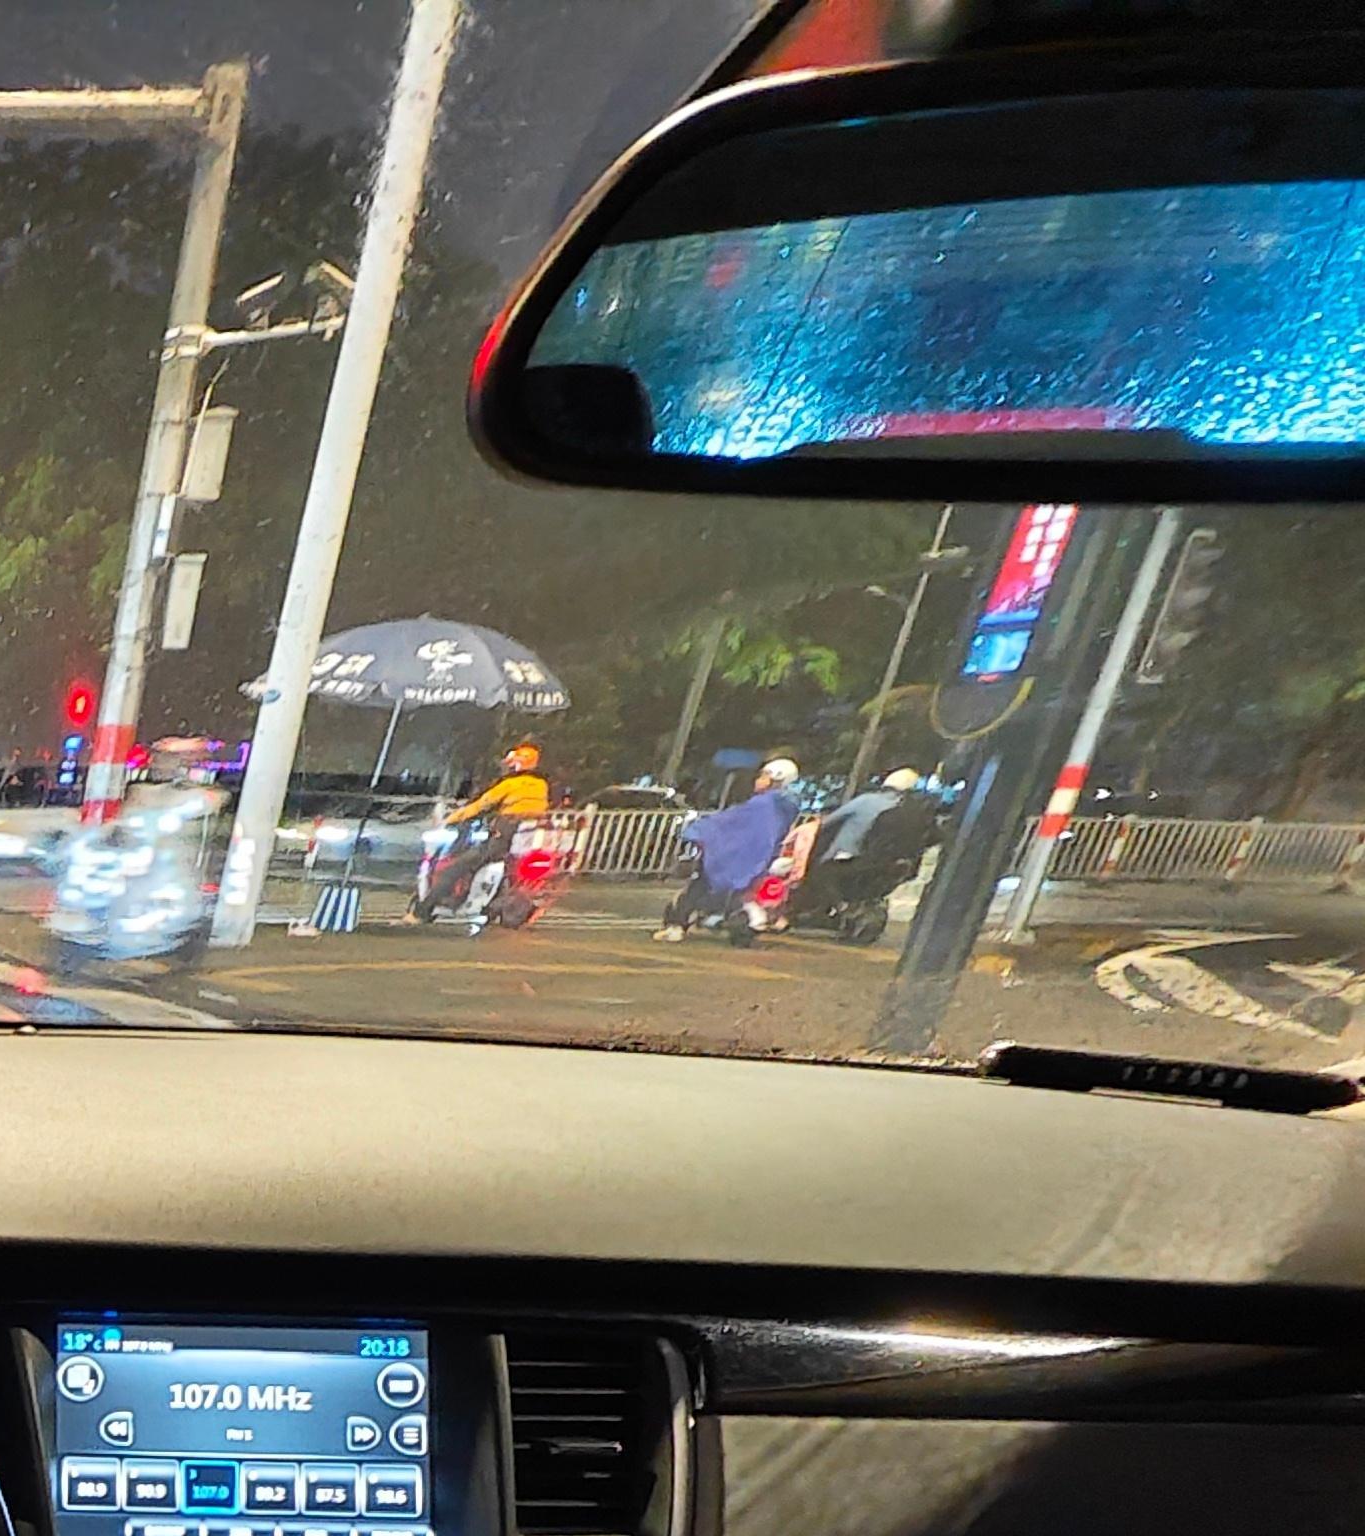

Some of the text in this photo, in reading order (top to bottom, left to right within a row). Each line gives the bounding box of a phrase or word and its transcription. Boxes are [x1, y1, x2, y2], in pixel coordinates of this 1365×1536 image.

[404, 686, 477, 702] WELCOME
[360, 1336, 411, 1357] 20:18
[169, 1383, 312, 1412] 107.0 MHz
